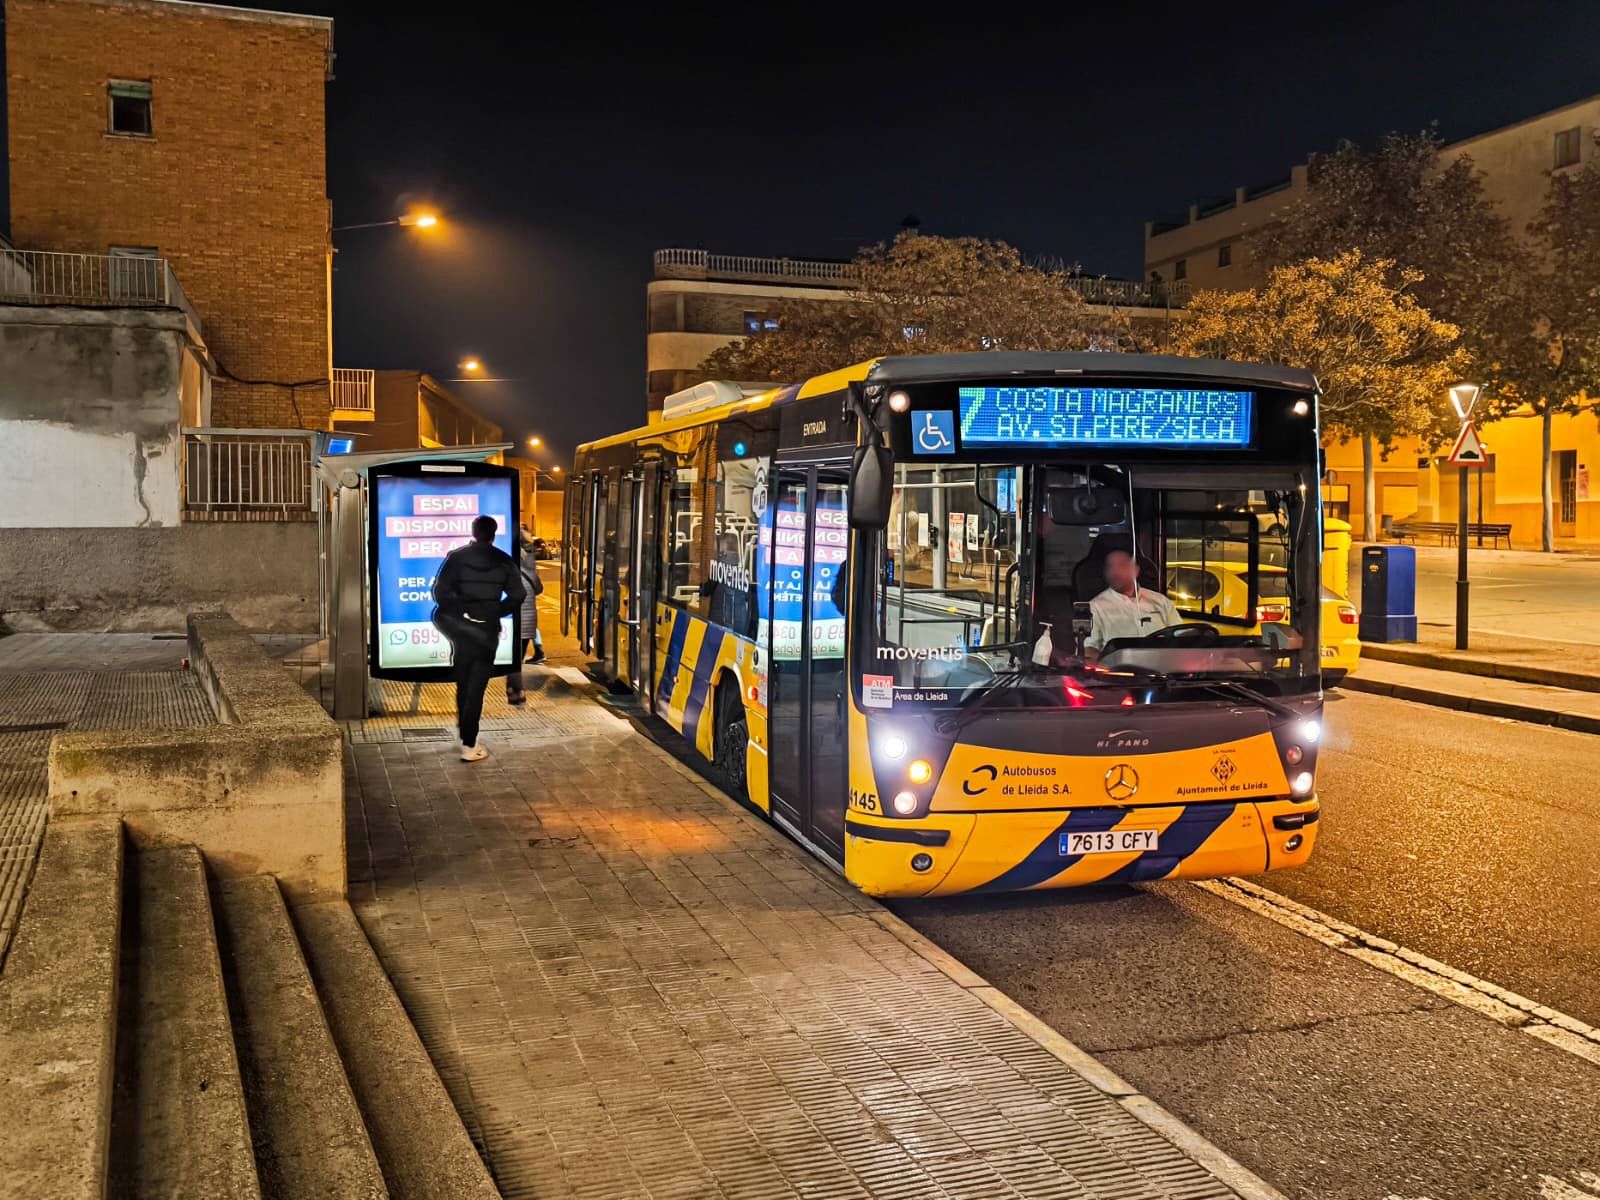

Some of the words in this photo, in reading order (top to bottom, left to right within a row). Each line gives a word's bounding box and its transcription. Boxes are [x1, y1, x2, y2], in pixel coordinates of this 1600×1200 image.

[996, 387, 1082, 412] COSTA
[1091, 389, 1239, 415] MAGRANERS
[959, 387, 986, 439] 7
[803, 420, 827, 437] ENTRADA
[997, 413, 1040, 437] AV.
[420, 498, 472, 511] ESPAI
[393, 519, 473, 533] DISPONI
[408, 541, 442, 554] PER
[398, 577, 426, 588] PER
[709, 560, 750, 593] moventis
[411, 628, 440, 645] 699
[876, 643, 963, 663] moventis
[871, 680, 891, 688] ATM
[913, 692, 924, 701] de
[925, 692, 948, 701] Lleida
[1002, 765, 1057, 776] Autobusos
[1002, 784, 1015, 795] de
[1018, 784, 1049, 795] Lleida
[1052, 784, 1072, 795] S.A.
[1176, 784, 1228, 796] Ajuntament
[1230, 783, 1241, 792] de
[1242, 781, 1269, 790] Lleida
[1072, 833, 1115, 852] 7613
[1122, 831, 1153, 850] CFY
